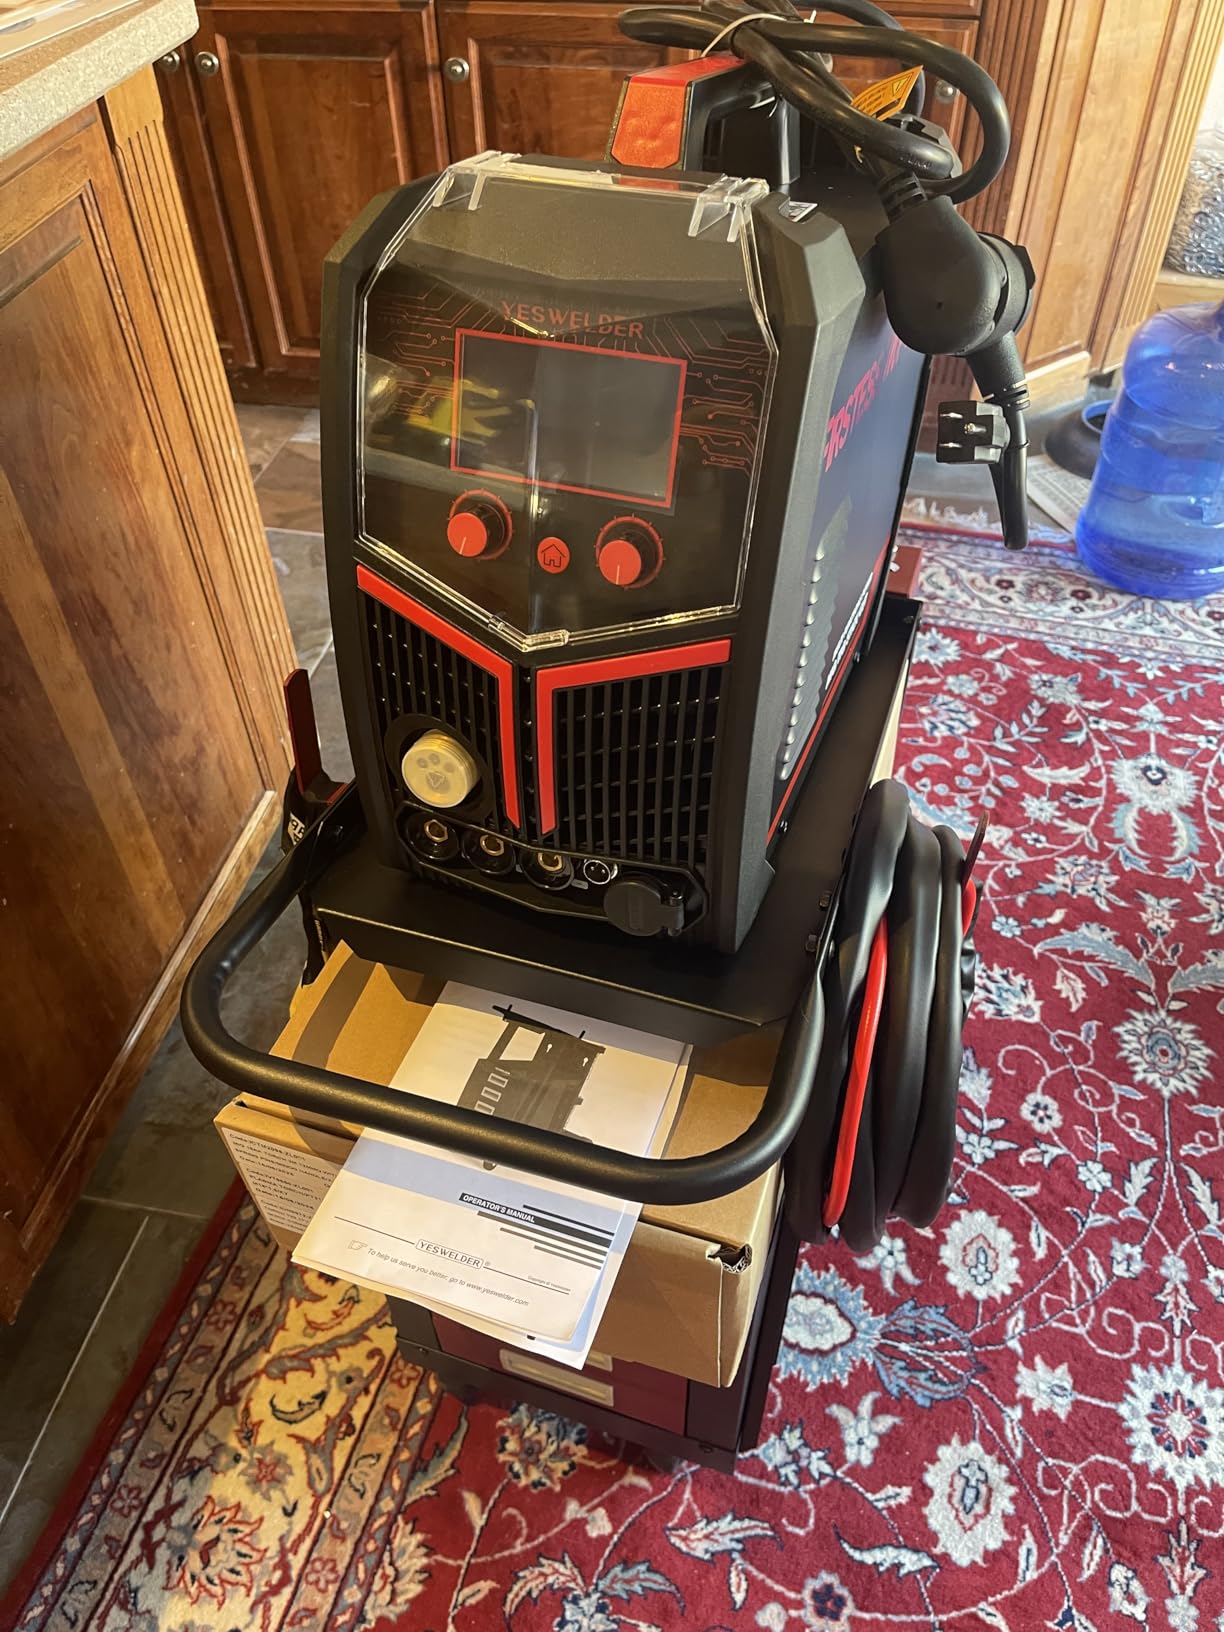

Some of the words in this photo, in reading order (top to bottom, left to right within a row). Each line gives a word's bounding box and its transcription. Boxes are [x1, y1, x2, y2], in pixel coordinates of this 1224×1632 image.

[500, 300, 645, 340] YESWELDER
[462, 1194, 507, 1214] OPERATOR'S
[507, 1208, 536, 1223] MANUAL
[420, 1241, 481, 1268] YESWELDER
[367, 1248, 377, 1256] To
[376, 1252, 390, 1261] help
[398, 1260, 417, 1270] serve
[415, 1266, 429, 1274] you
[466, 1282, 530, 1306] www.yeswelder.com
